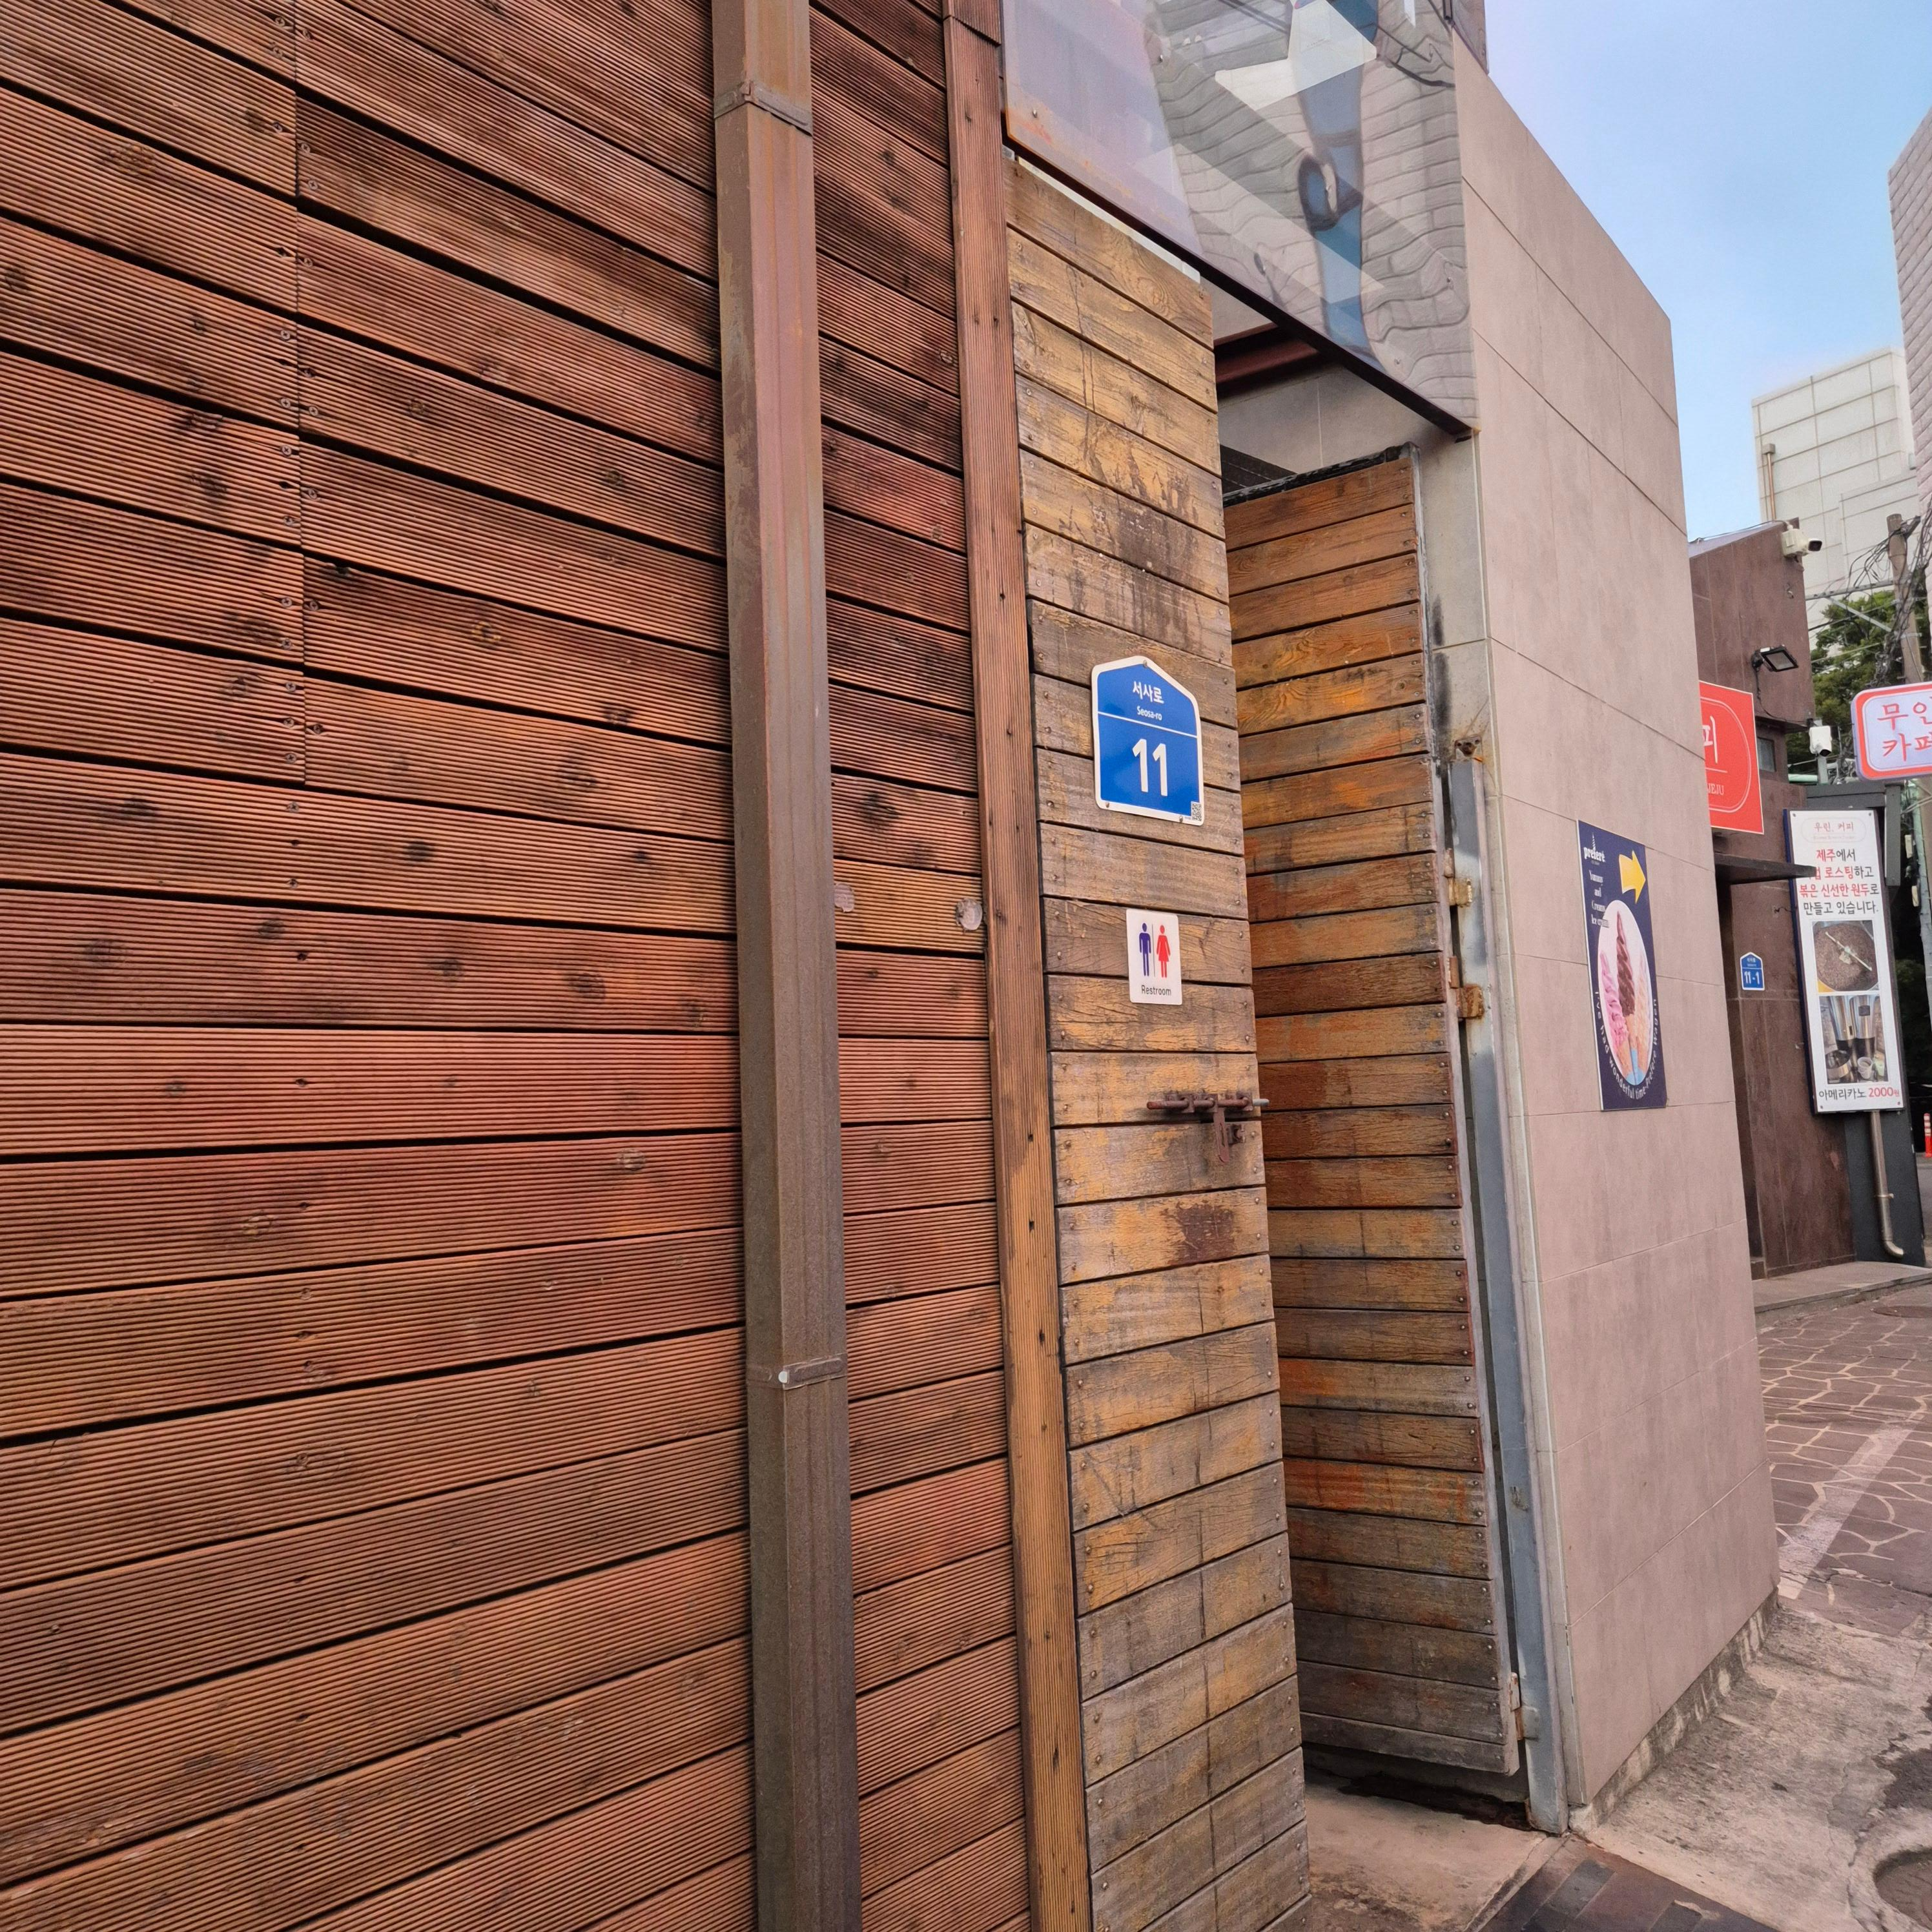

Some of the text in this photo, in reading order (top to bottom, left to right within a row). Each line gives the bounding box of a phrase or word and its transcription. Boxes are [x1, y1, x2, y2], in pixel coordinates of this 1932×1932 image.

[1132, 681, 1164, 704] 서사로
[1136, 706, 1162, 721] Seosa-ro
[1132, 738, 1168, 797] 11
[1838, 821, 1854, 831] 커피
[1816, 848, 1856, 862] 제주에서
[1824, 865, 1874, 879] 로스팅하고
[1799, 883, 1880, 898] 볶은 신선한 원두로
[1804, 901, 1879, 916] 만들고 있습니다.
[1744, 971, 1760, 985] 11-1
[1141, 984, 1172, 996] Restroom
[1600, 1025, 1610, 1054] had
[1609, 1056, 1636, 1100] wonderful
[1818, 1087, 1899, 1101] 아메리카노 2000원
